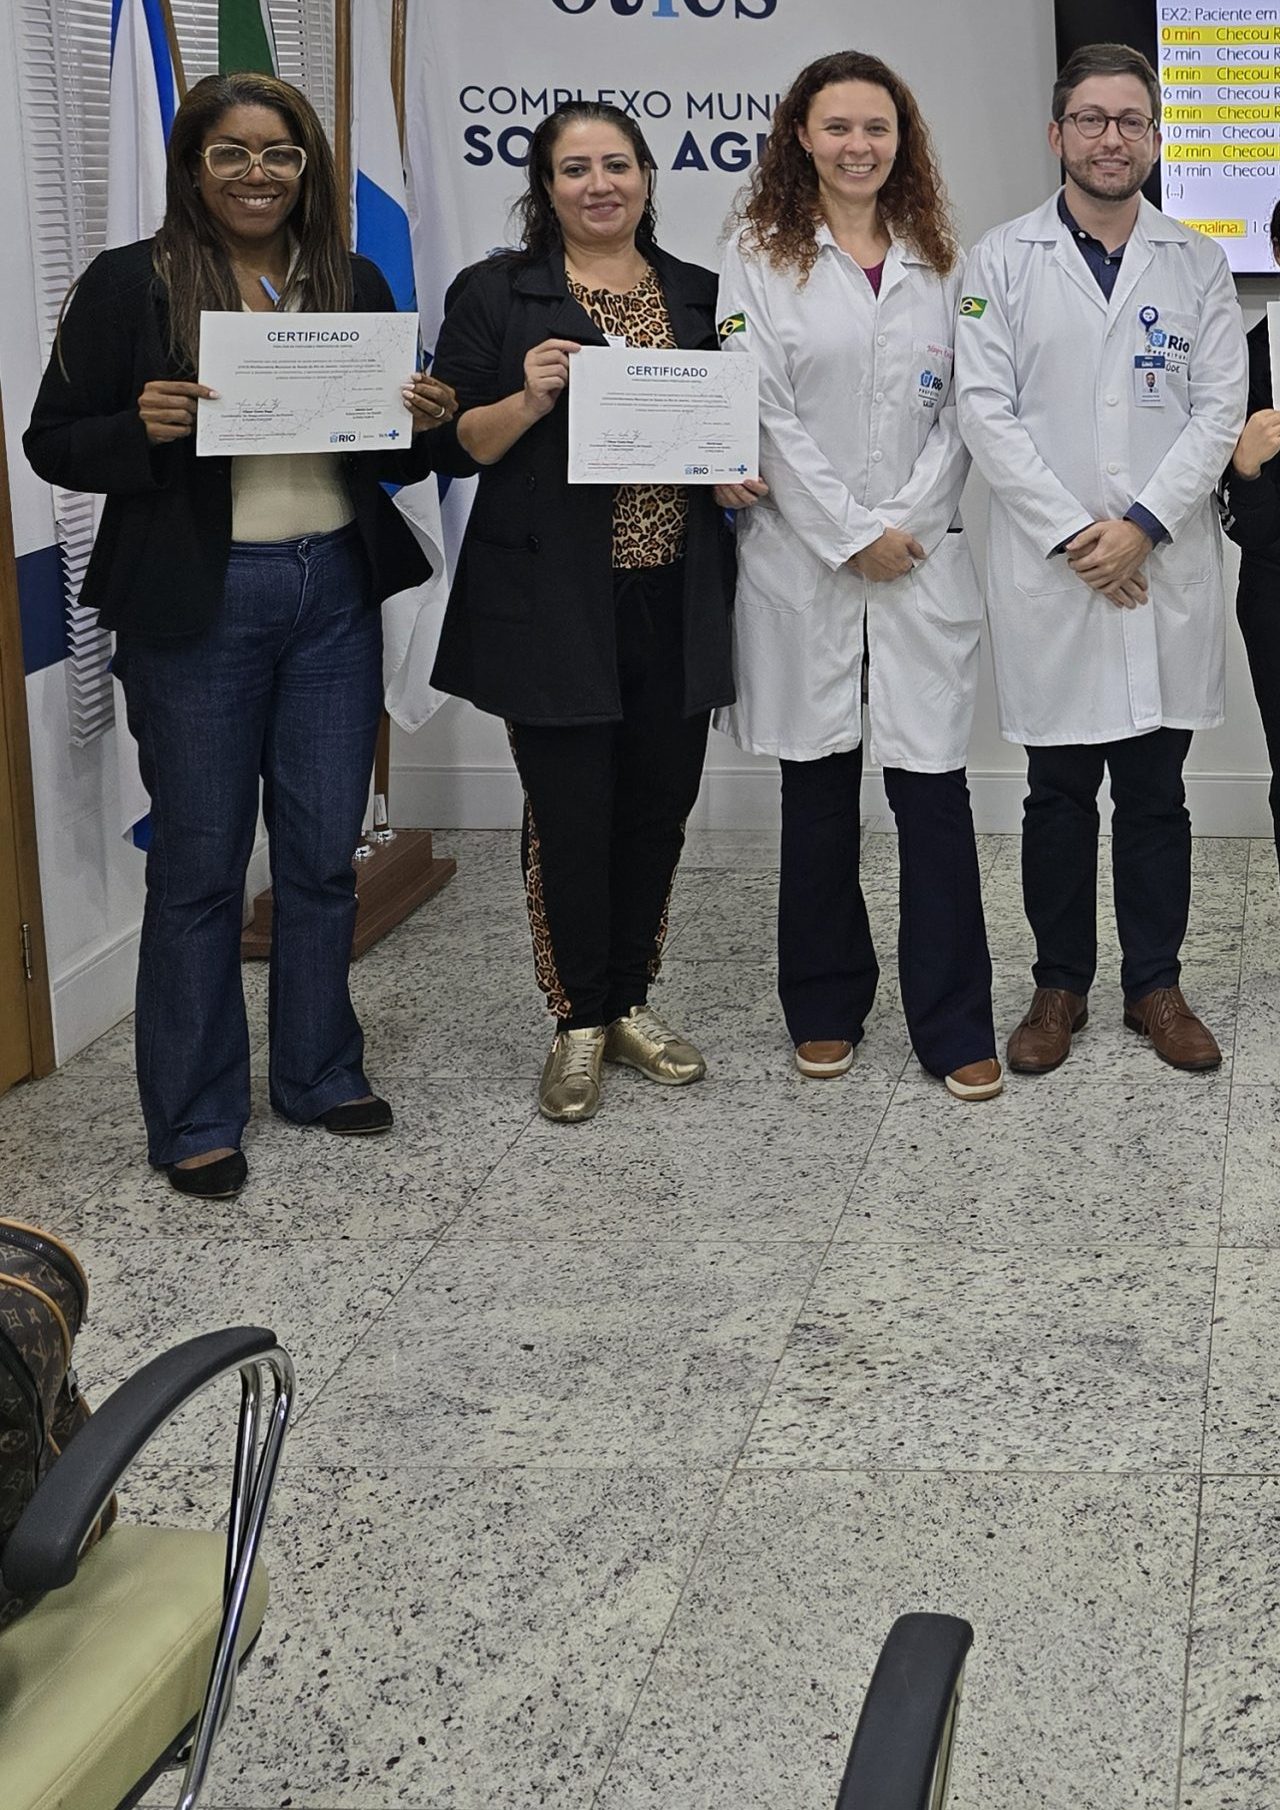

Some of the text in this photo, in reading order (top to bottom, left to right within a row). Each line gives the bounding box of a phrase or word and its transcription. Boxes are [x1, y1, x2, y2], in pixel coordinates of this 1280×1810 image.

[1162, 8, 1192, 20] EX2:
[1195, 8, 1252, 20] Paciente
[1256, 9, 1277, 20] em
[1162, 29, 1170, 40] 0
[1175, 29, 1200, 40] min
[1216, 28, 1269, 40] Checou
[1162, 48, 1171, 60] 2
[1175, 48, 1200, 60] min
[1216, 48, 1269, 60] Checou
[1162, 68, 1170, 80] 4
[1175, 68, 1201, 80] min
[1216, 67, 1269, 79] Checou
[1164, 87, 1172, 99] 6
[1176, 88, 1201, 99] min
[1217, 87, 1270, 98] Checou
[1164, 107, 1173, 118] 8
[1177, 107, 1202, 118] min
[1217, 106, 1270, 118] Checou
[1167, 126, 1183, 138] 10
[1185, 126, 1211, 138] min
[1223, 125, 1275, 137] Checou
[1167, 145, 1183, 157] 12
[1185, 146, 1211, 157] min
[1223, 145, 1275, 157] Checou
[1167, 165, 1183, 177] 14
[1186, 165, 1211, 176] min
[1223, 164, 1275, 176] Checou
[267, 331, 360, 342] CERTIFICADO
[1168, 334, 1190, 353] Rio
[626, 366, 708, 378] CERTIFICADO
[338, 434, 356, 442] RIO
[693, 467, 709, 475] RIO
